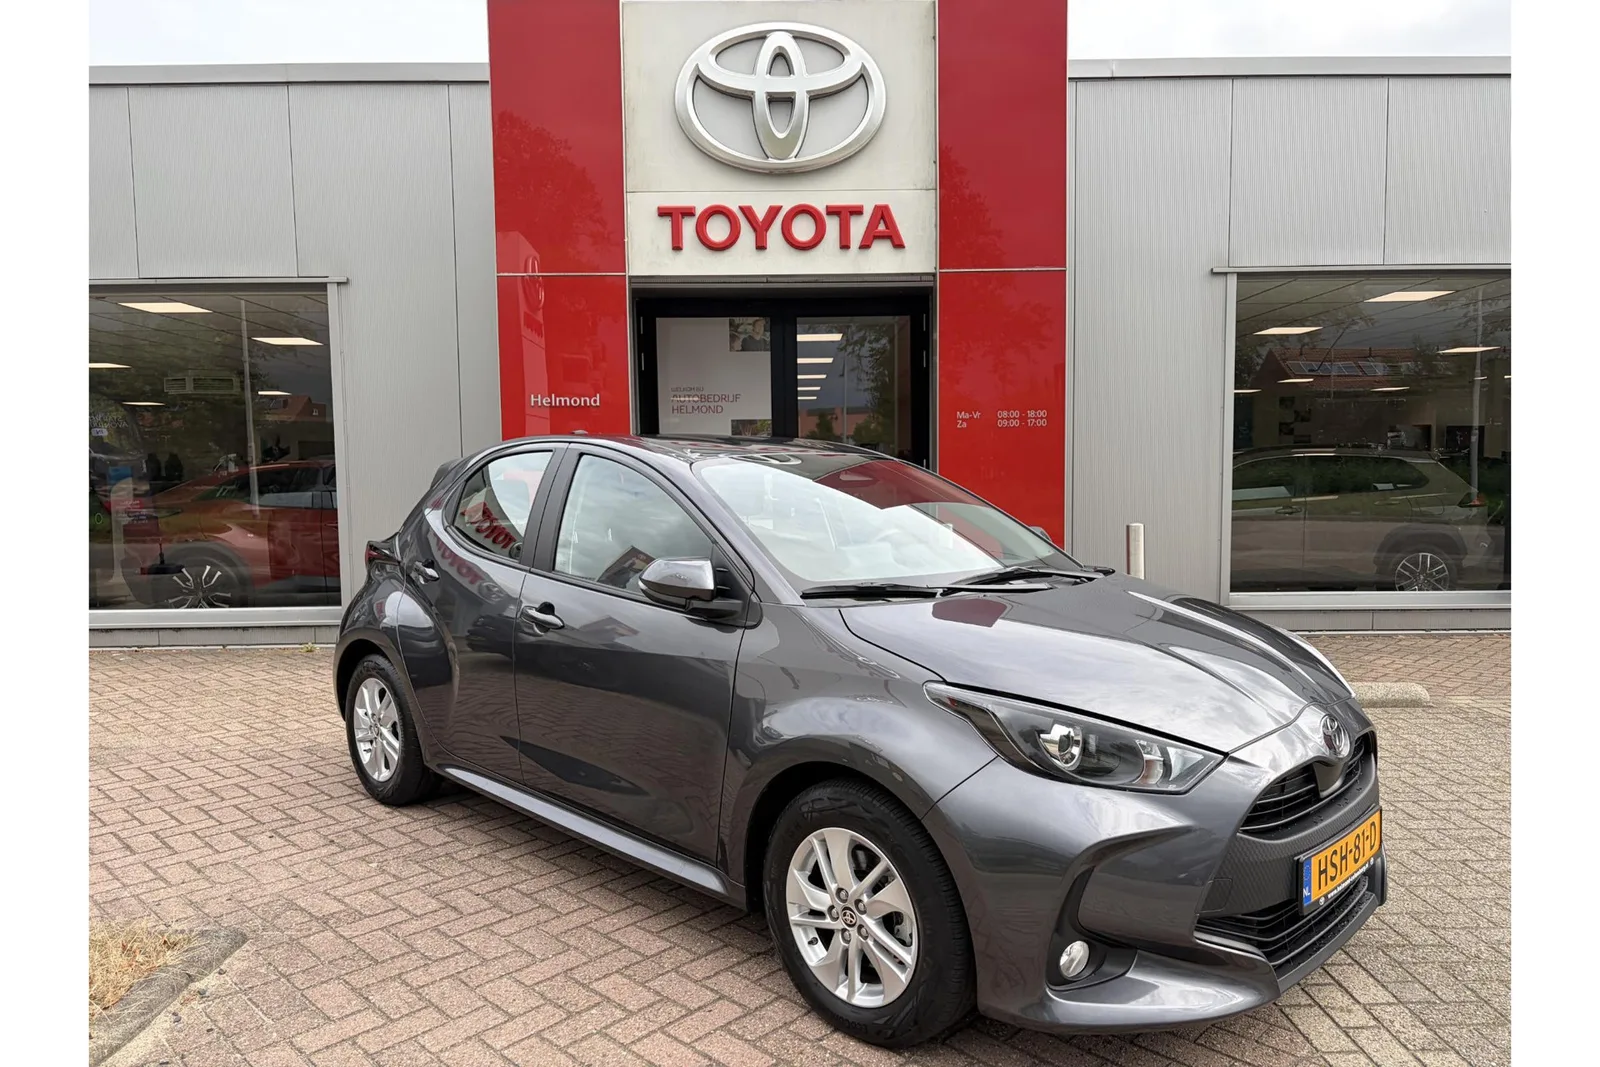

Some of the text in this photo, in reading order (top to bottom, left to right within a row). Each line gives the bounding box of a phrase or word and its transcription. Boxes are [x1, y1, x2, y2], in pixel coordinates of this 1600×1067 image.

[657, 203, 905, 251] TOYOTA
[530, 392, 601, 409] Helmond
[671, 394, 741, 403] AUTOBEDRIJF
[671, 405, 724, 414] HELMOND
[956, 411, 981, 419] Ma-Vr
[997, 410, 1020, 418] 08:00
[1027, 409, 1047, 418] 18:00
[956, 420, 967, 428] Za
[997, 419, 1020, 427] 09:00
[1027, 418, 1047, 427] 17:00
[1318, 821, 1377, 891] HSH-81-D
[1303, 886, 1311, 898] NL
